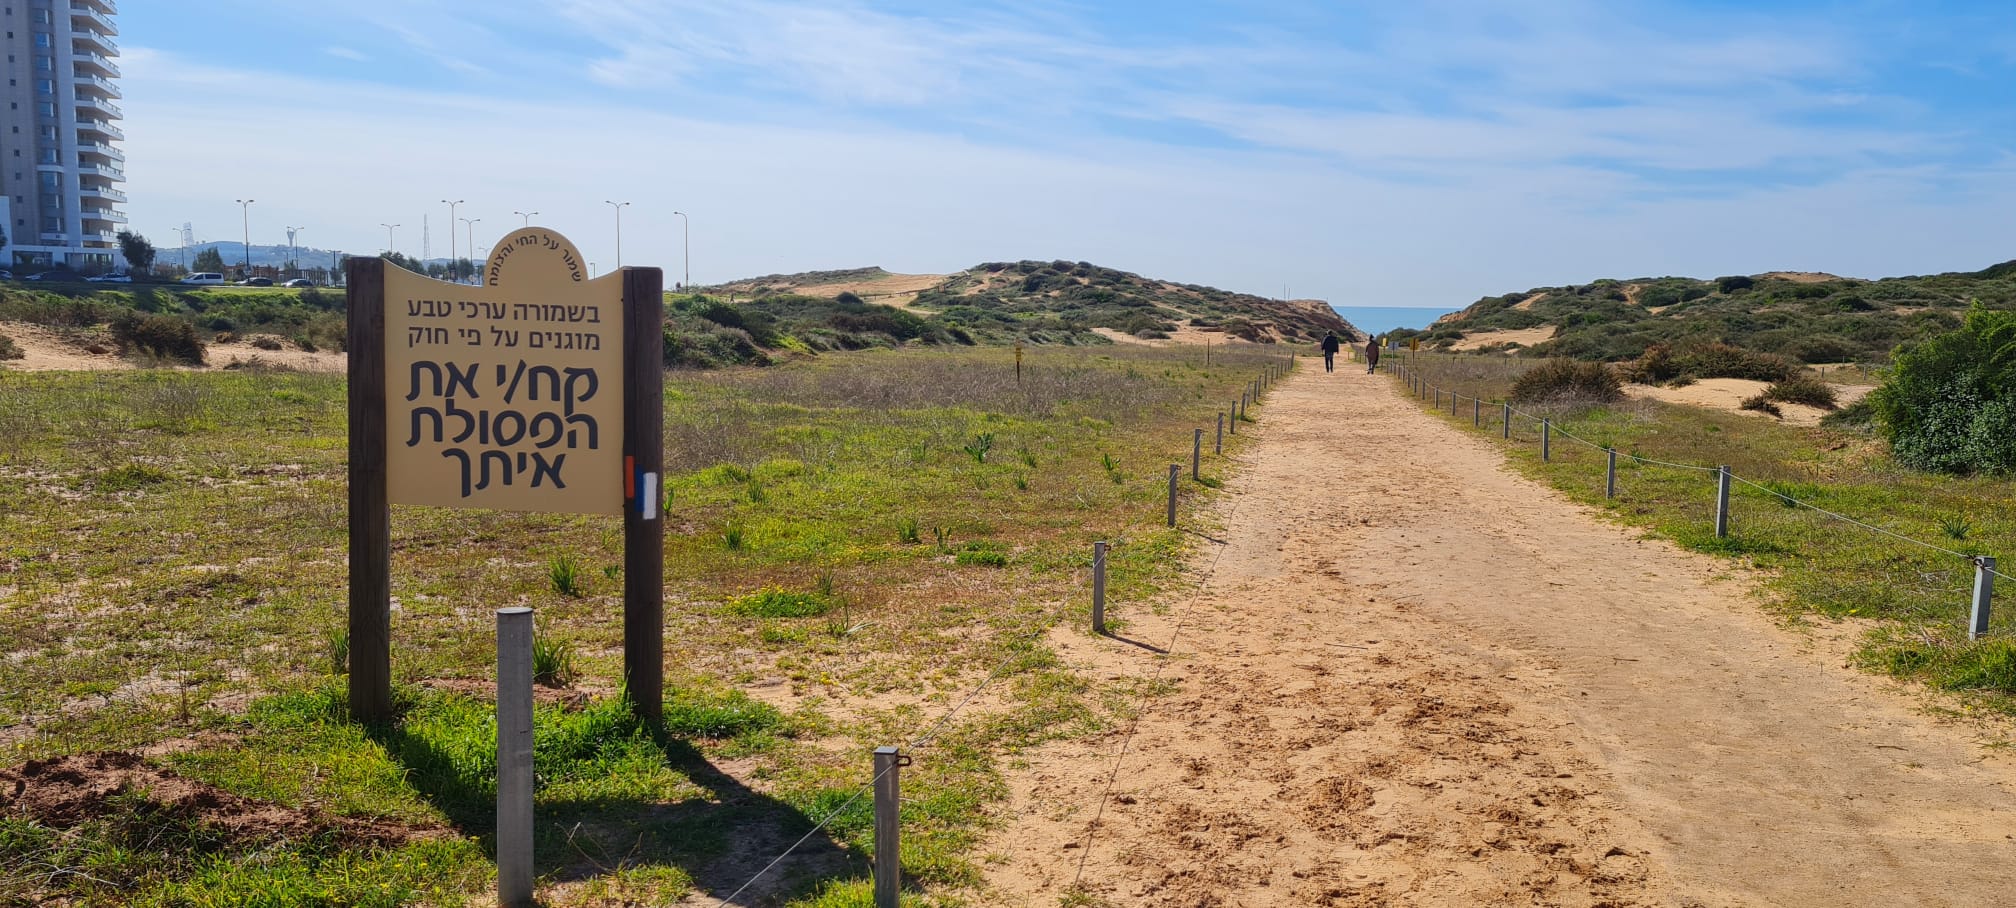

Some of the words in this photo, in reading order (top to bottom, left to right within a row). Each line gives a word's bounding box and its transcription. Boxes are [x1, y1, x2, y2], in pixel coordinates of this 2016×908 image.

[515, 234, 538, 247] החי
[543, 234, 560, 250] על
[489, 243, 515, 287] והצומח
[562, 248, 582, 282] שמור
[408, 300, 452, 318] טבע
[457, 302, 506, 320] ערכי
[514, 303, 600, 323] בשמורה
[408, 326, 449, 349] חוק
[458, 328, 481, 346] פי
[490, 326, 519, 348] על
[528, 331, 600, 351] מוגנים
[405, 361, 479, 402] את
[497, 359, 599, 417] קח/י
[405, 398, 599, 450] הפסולת
[441, 447, 567, 499] איתך
